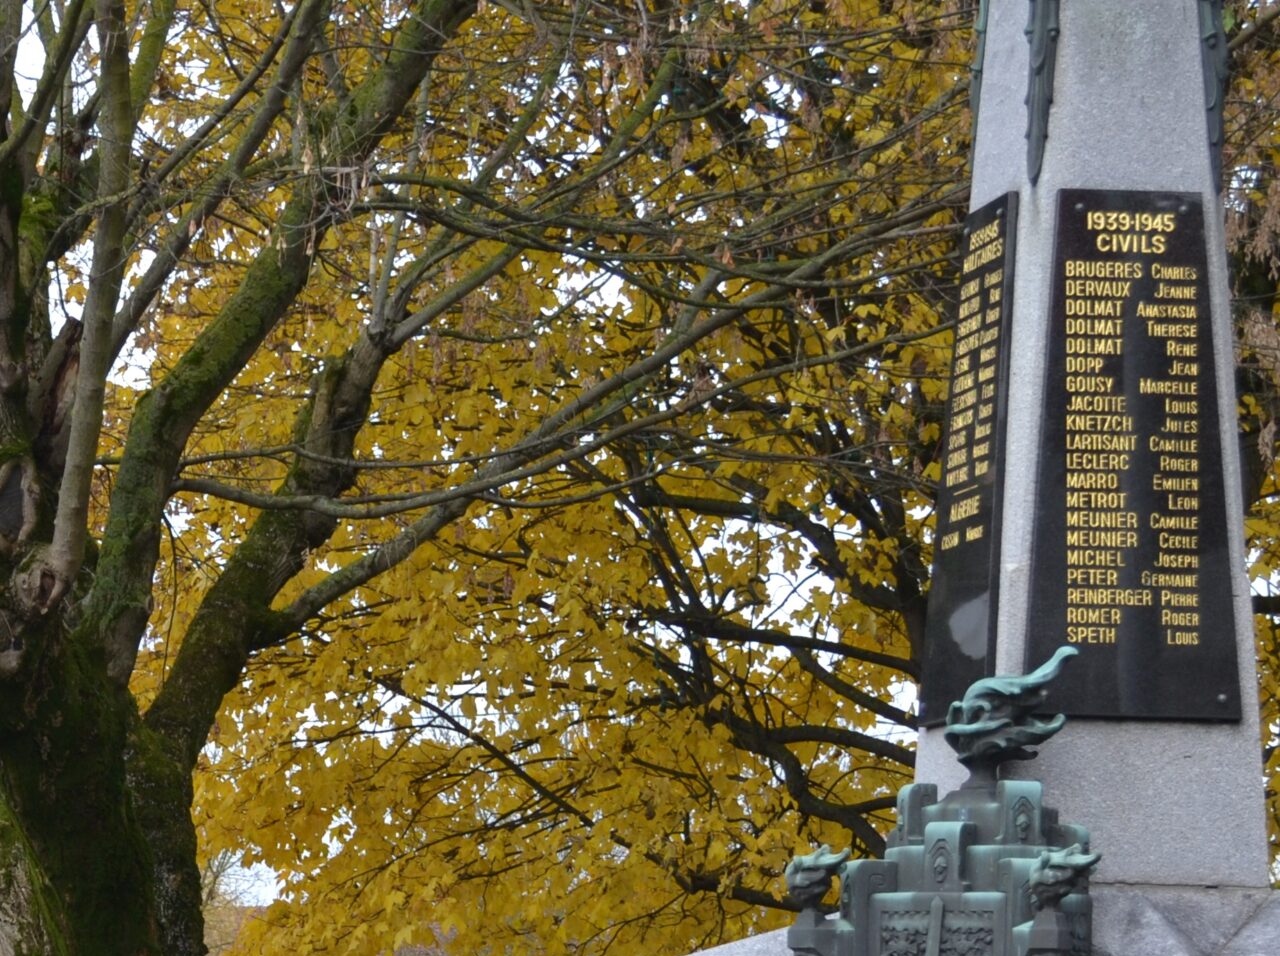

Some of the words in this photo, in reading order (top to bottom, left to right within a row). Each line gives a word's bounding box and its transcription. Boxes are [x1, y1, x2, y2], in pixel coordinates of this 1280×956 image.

[1096, 234, 1166, 254] CIVILS
[1065, 261, 1142, 278] BRUGERES
[1066, 280, 1131, 297] DERVAUX
[1066, 300, 1123, 316] DOLMAT
[1066, 319, 1123, 335] DOLMAT
[1066, 338, 1123, 354] DOLMAT
[1066, 357, 1104, 373] DOPP
[1066, 376, 1113, 393] GOUSY
[1066, 396, 1126, 413] JACOTTE
[1066, 415, 1133, 431] KNETZCH
[1066, 435, 1137, 451] LARTISANT
[1066, 453, 1130, 470] LECLERC
[1066, 473, 1118, 489] MARRO
[1066, 492, 1126, 508] METROT
[949, 495, 981, 523] ALGERIE
[1066, 511, 1138, 528] MEUNIER
[1067, 531, 1138, 547] MEUNIER
[1067, 550, 1126, 566] MICHEL
[1067, 569, 1118, 585] PETER
[1067, 589, 1152, 605] REINBERGER
[1067, 608, 1121, 624] ROMER
[1067, 627, 1116, 643] SPETH
